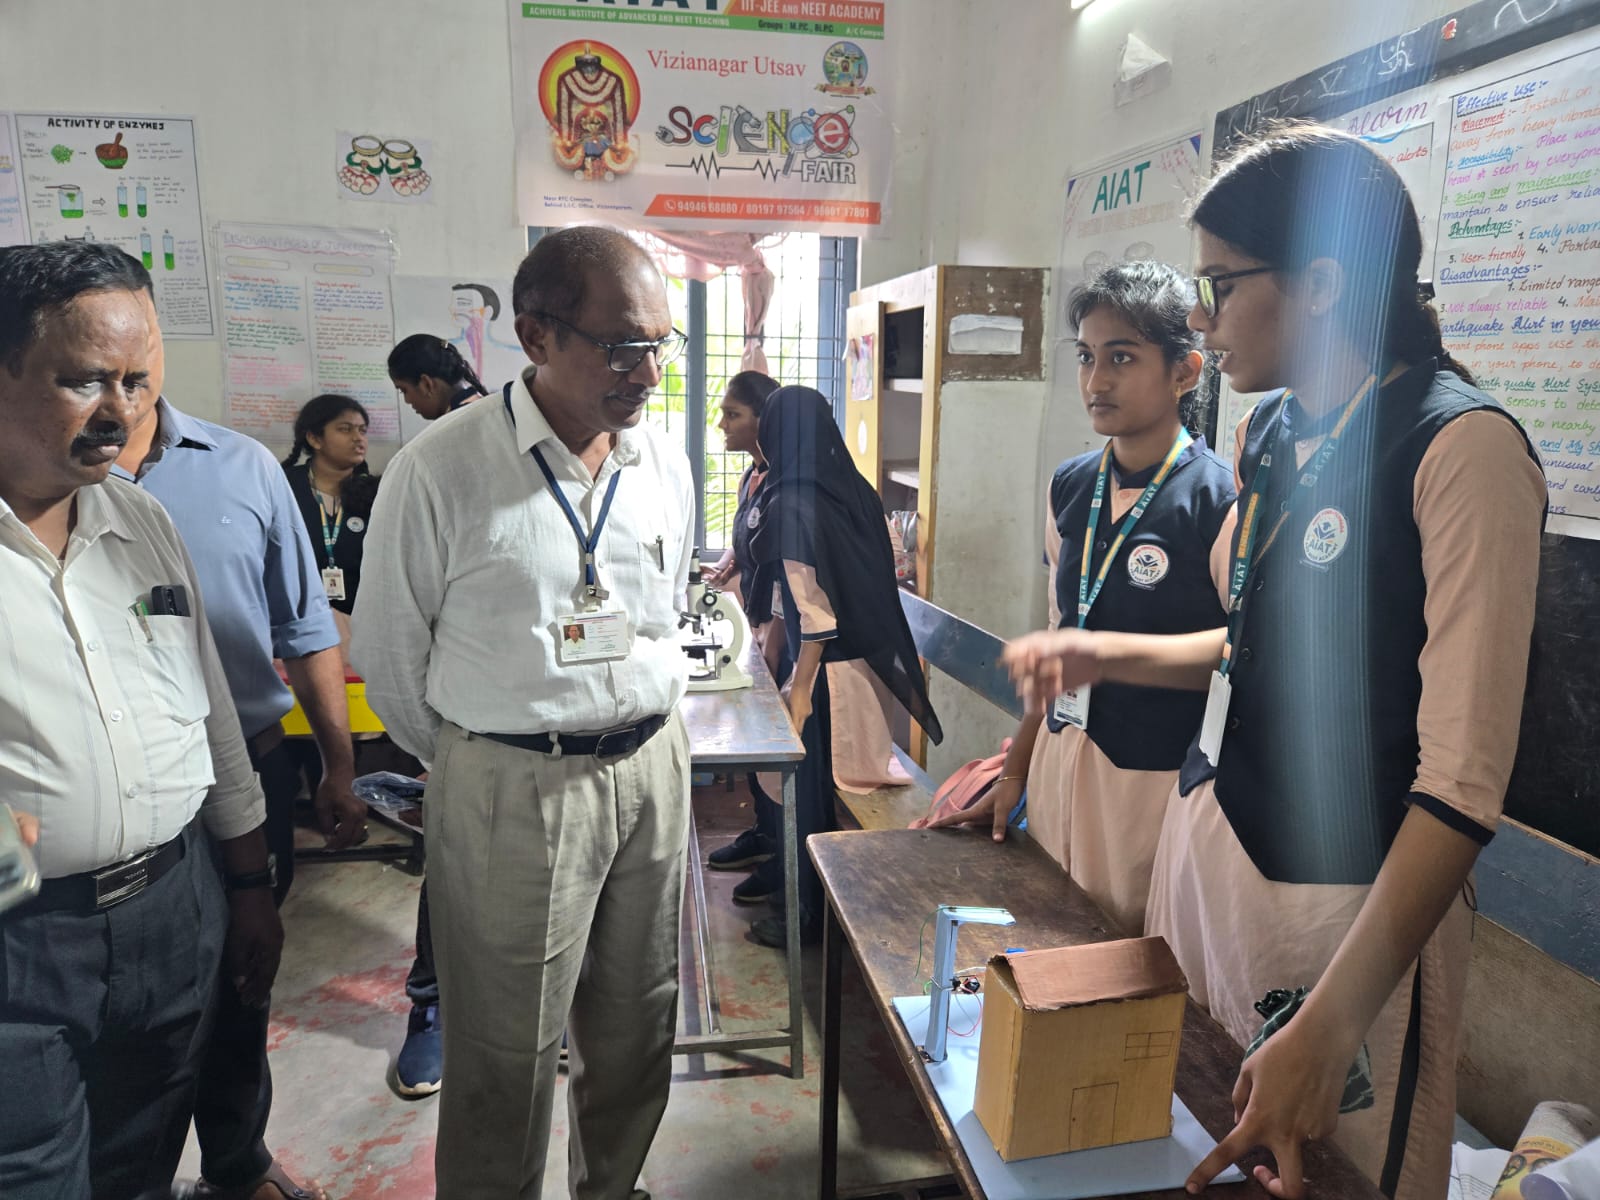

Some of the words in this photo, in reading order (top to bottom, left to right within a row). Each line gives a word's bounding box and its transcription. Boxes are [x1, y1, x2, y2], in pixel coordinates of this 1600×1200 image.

[529, 6, 566, 17] ACHIVERS
[568, 10, 605, 19] INSTITUTE
[618, 13, 657, 23] ADVANCED
[658, 15, 673, 23] AND
[675, 16, 693, 24] NEET
[695, 17, 730, 26] TEACHING
[782, 5, 798, 14] AND
[801, 0, 826, 16] NEET
[829, 3, 881, 20] ACADEMY
[647, 49, 748, 77] Vizianagar
[753, 56, 806, 77] Utsav
[1457, 90, 1508, 115] Effective
[47, 117, 100, 129] ACTIVITY
[103, 119, 116, 129] OF
[118, 120, 165, 131] ENZYMES
[1349, 101, 1428, 136] Alarm
[1450, 136, 1480, 152] away
[1521, 113, 1557, 134] heavy
[1536, 131, 1568, 148] Place
[1397, 146, 1429, 163] alerts
[801, 160, 857, 184] FAIR
[1491, 161, 1520, 178] seen
[1525, 155, 1541, 176] by
[1091, 160, 1152, 215] AIAT
[1441, 205, 1492, 221] maintain
[1496, 202, 1508, 213] to
[1515, 191, 1560, 210] ensure
[1528, 223, 1563, 246] Early
[1537, 242, 1549, 256] 4.
[1518, 274, 1567, 292] Limited
[1467, 298, 1502, 318] always
[1505, 296, 1549, 312] reliable
[1557, 296, 1569, 308] 4.
[1511, 315, 1546, 331] Alert
[1551, 317, 1564, 330] in
[1473, 339, 1506, 356] phone
[1511, 341, 1541, 356] apps
[1547, 338, 1575, 350] use
[1471, 359, 1482, 369] in
[1487, 359, 1517, 373] your
[1567, 358, 1583, 370] to
[1504, 396, 1547, 409] sensors
[1553, 397, 1568, 409] to
[1533, 417, 1546, 429] to
[1551, 419, 1597, 437] nearby
[1539, 437, 1562, 450] and
